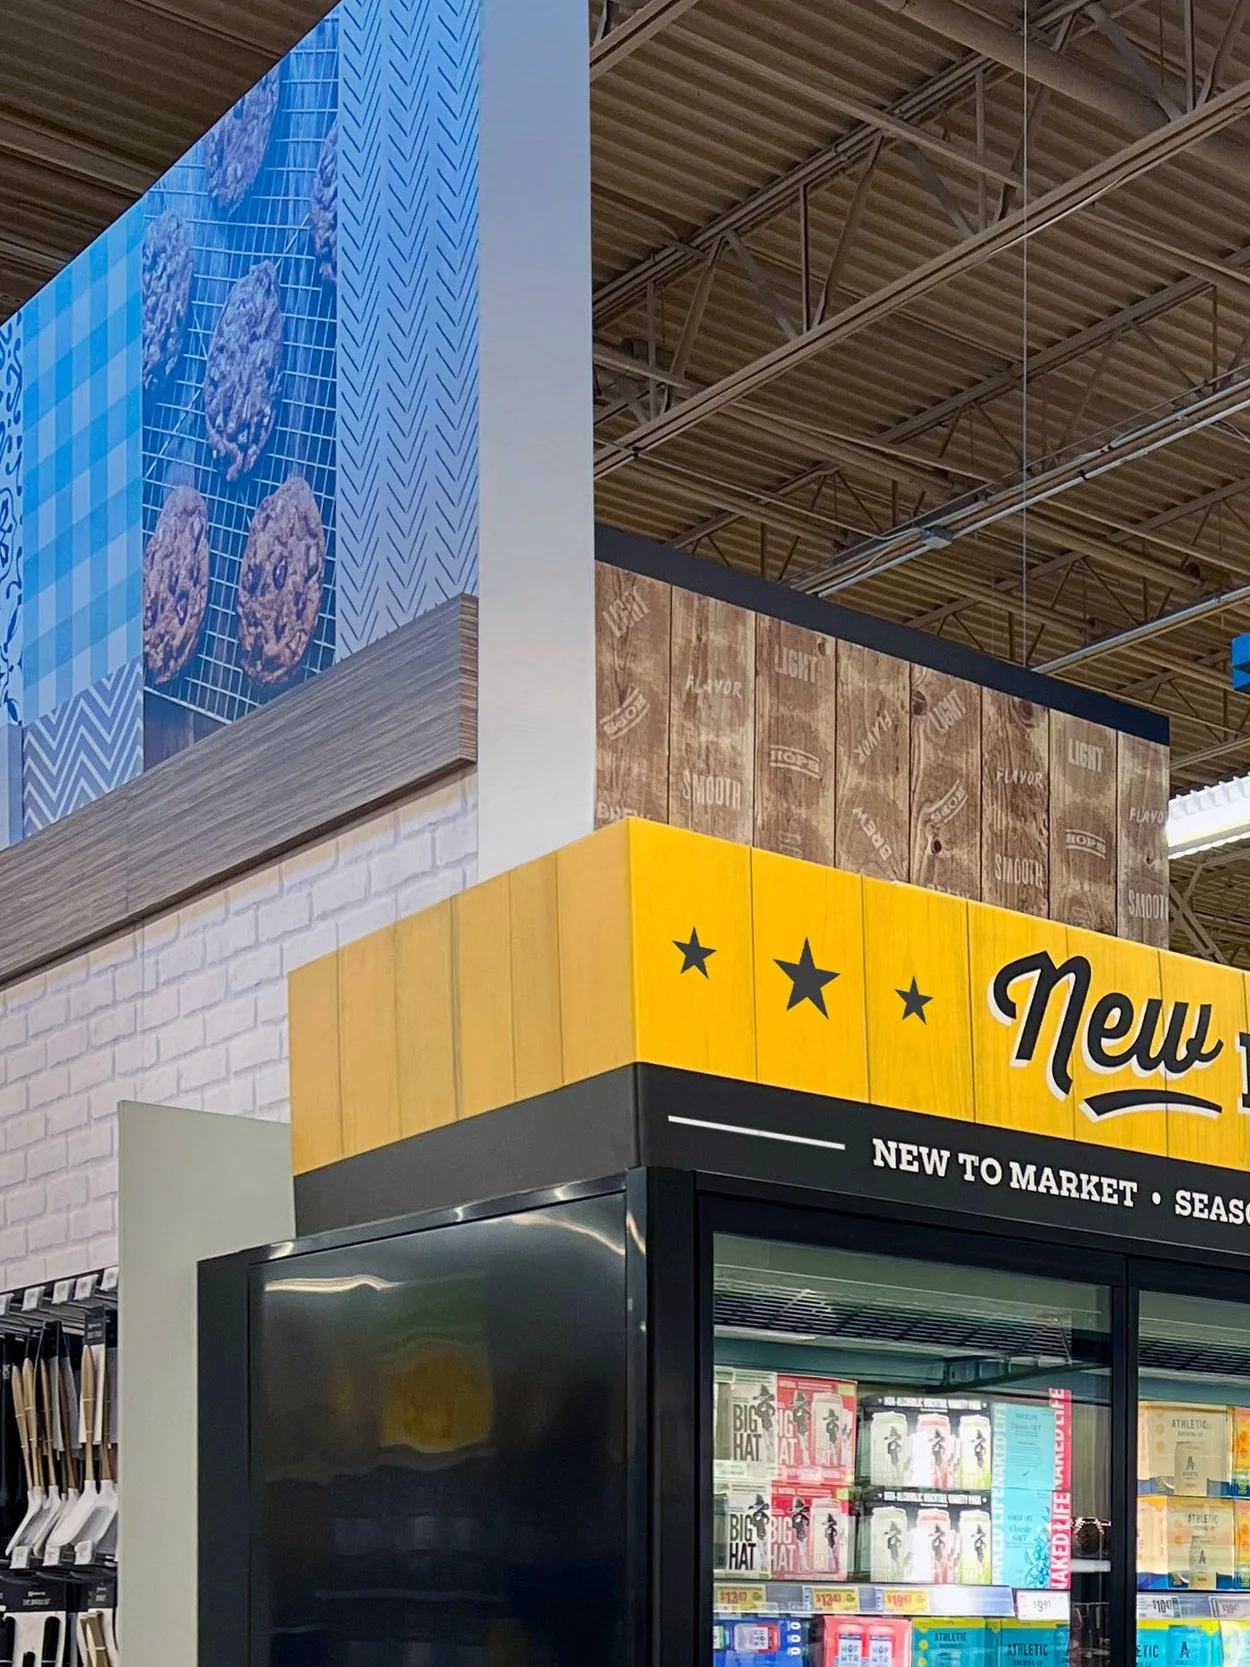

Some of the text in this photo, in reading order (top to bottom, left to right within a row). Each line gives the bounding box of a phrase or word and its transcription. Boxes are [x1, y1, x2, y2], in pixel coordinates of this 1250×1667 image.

[1068, 739, 1104, 773] LIGHT
[987, 951, 1223, 1101] New
[873, 1137, 1138, 1208] NEW TO MARKET
[733, 1404, 758, 1433] BIG
[1172, 1418, 1208, 1430] ATHLETIC
[733, 1433, 761, 1462] HAT
[1049, 1388, 1064, 1490] NAKED LIFE
[730, 1514, 752, 1542] BIG
[729, 1543, 756, 1571] HAT
[935, 1632, 967, 1642] ATHLETIC
[1007, 1643, 1049, 1657] ATHLETIC
